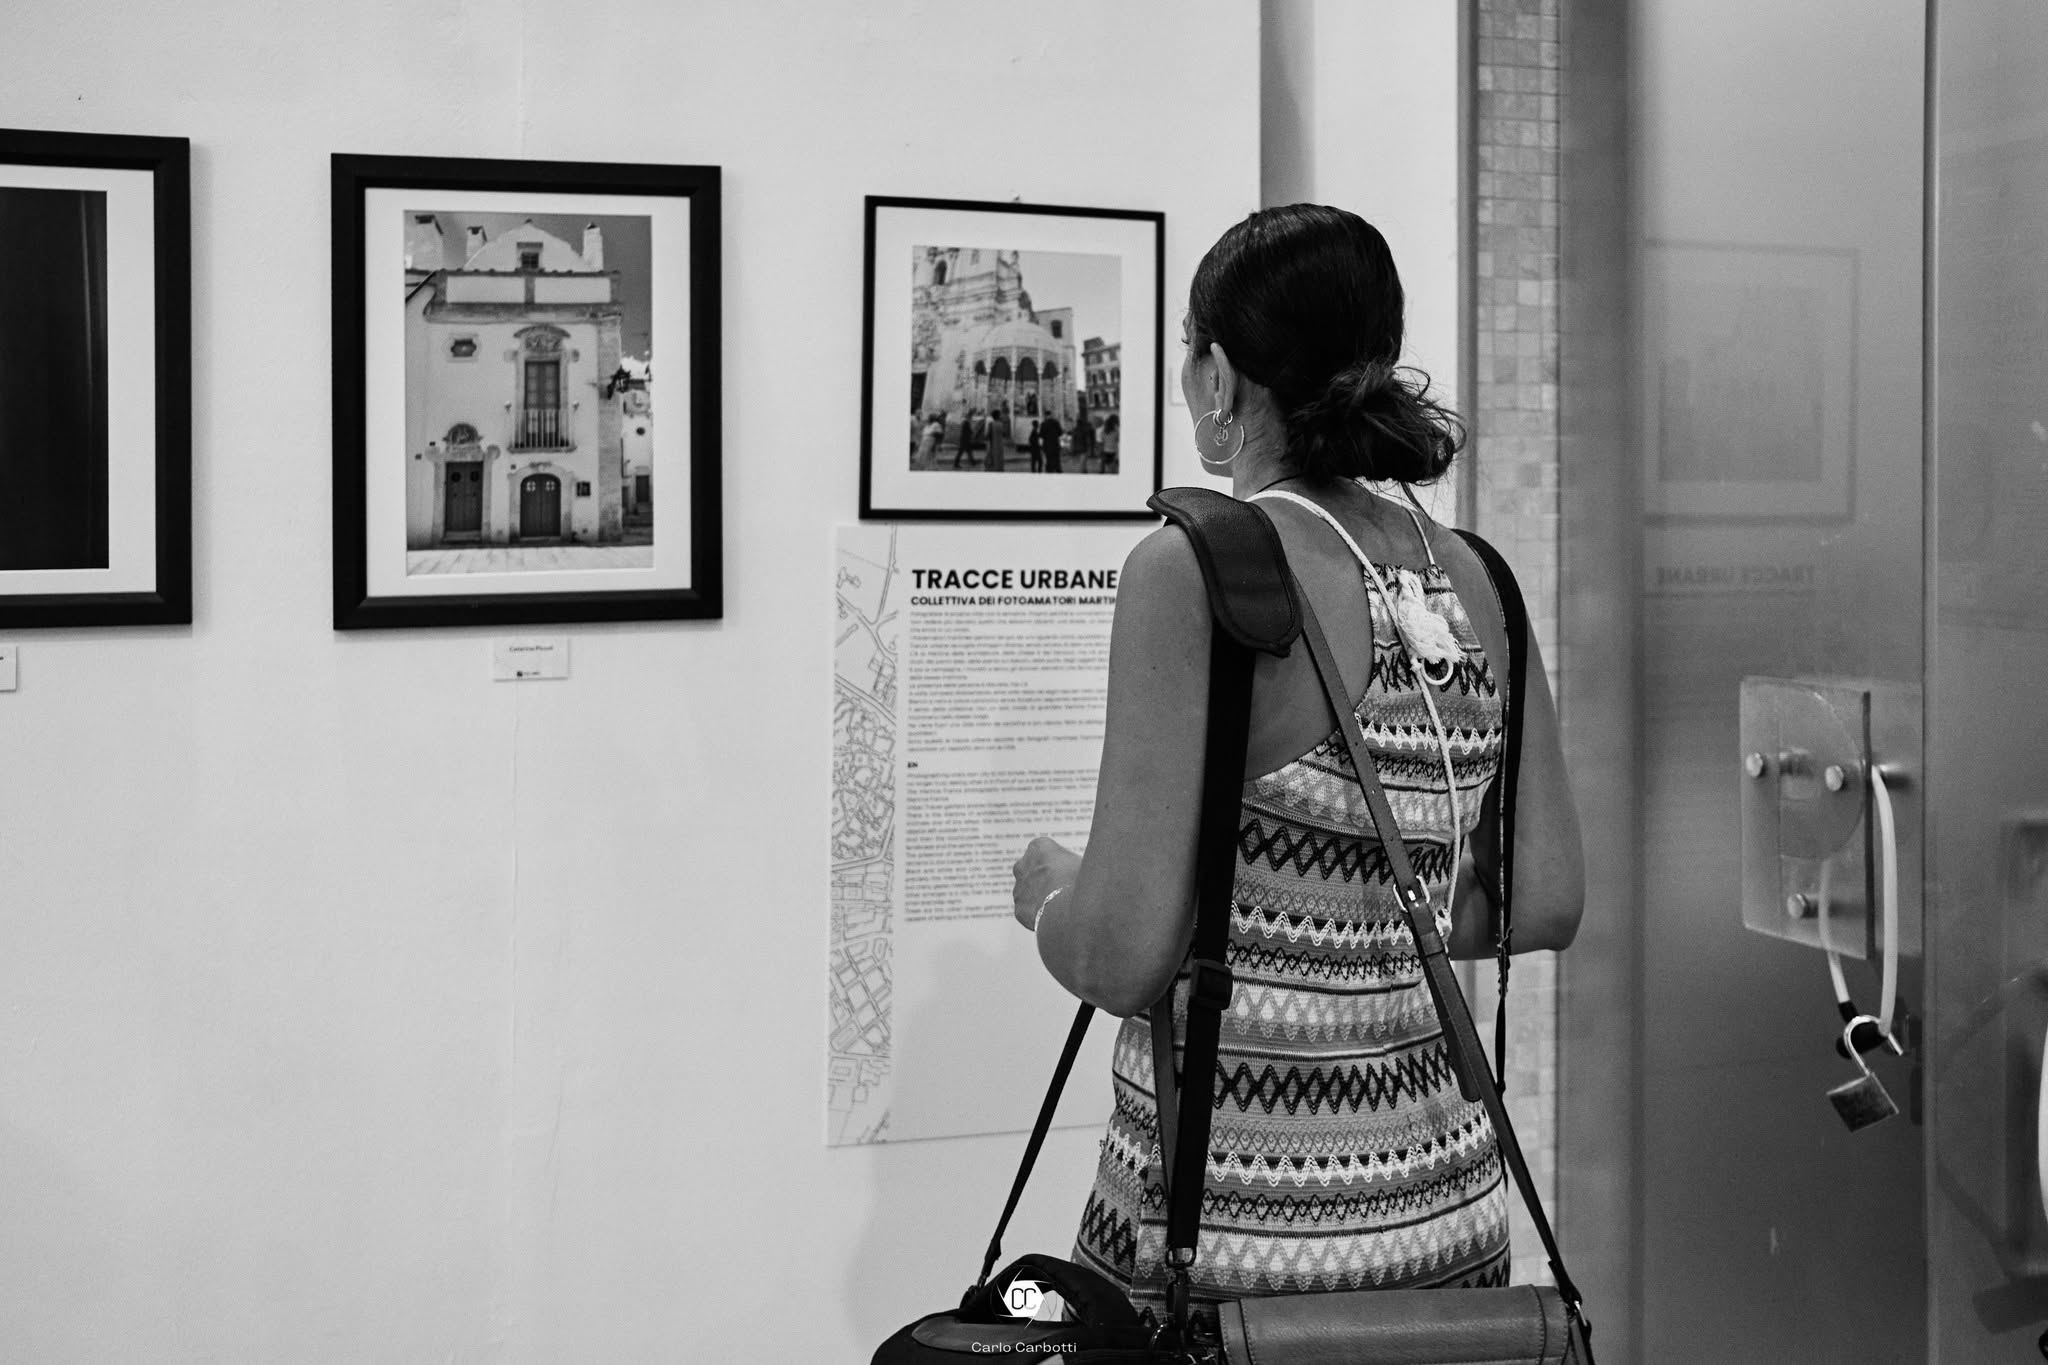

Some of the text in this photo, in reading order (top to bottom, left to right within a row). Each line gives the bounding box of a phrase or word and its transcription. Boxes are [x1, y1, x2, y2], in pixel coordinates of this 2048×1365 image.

[911, 568, 1118, 589] TRACCE URBANE
[911, 595, 976, 606] COLLETTIVA
[978, 595, 996, 606] DEI
[997, 595, 1076, 606] FOTOAMATORI
